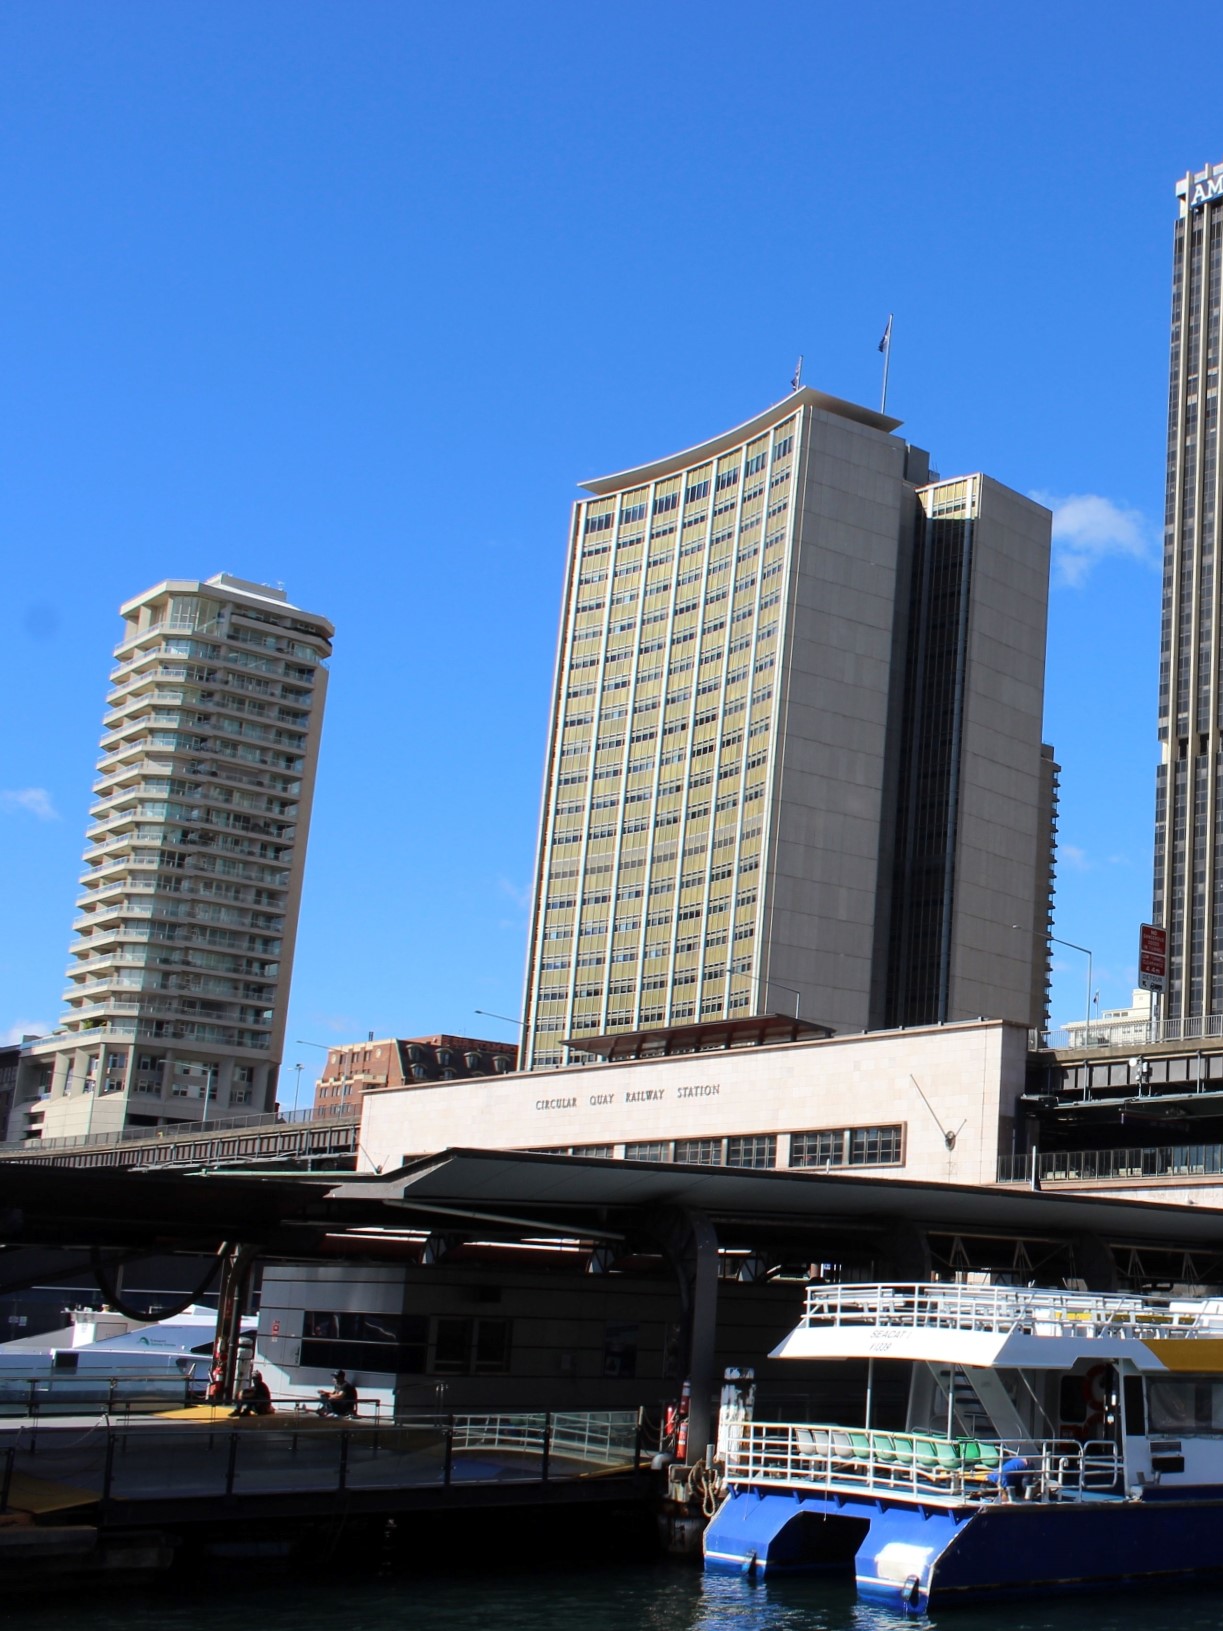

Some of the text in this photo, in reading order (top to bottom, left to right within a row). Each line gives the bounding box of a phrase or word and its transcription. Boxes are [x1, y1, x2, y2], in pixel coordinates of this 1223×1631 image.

[536, 1084, 720, 1110] CIRCULAR QUAY RAILWAY STATION
[870, 1329, 907, 1339] SEACAT
